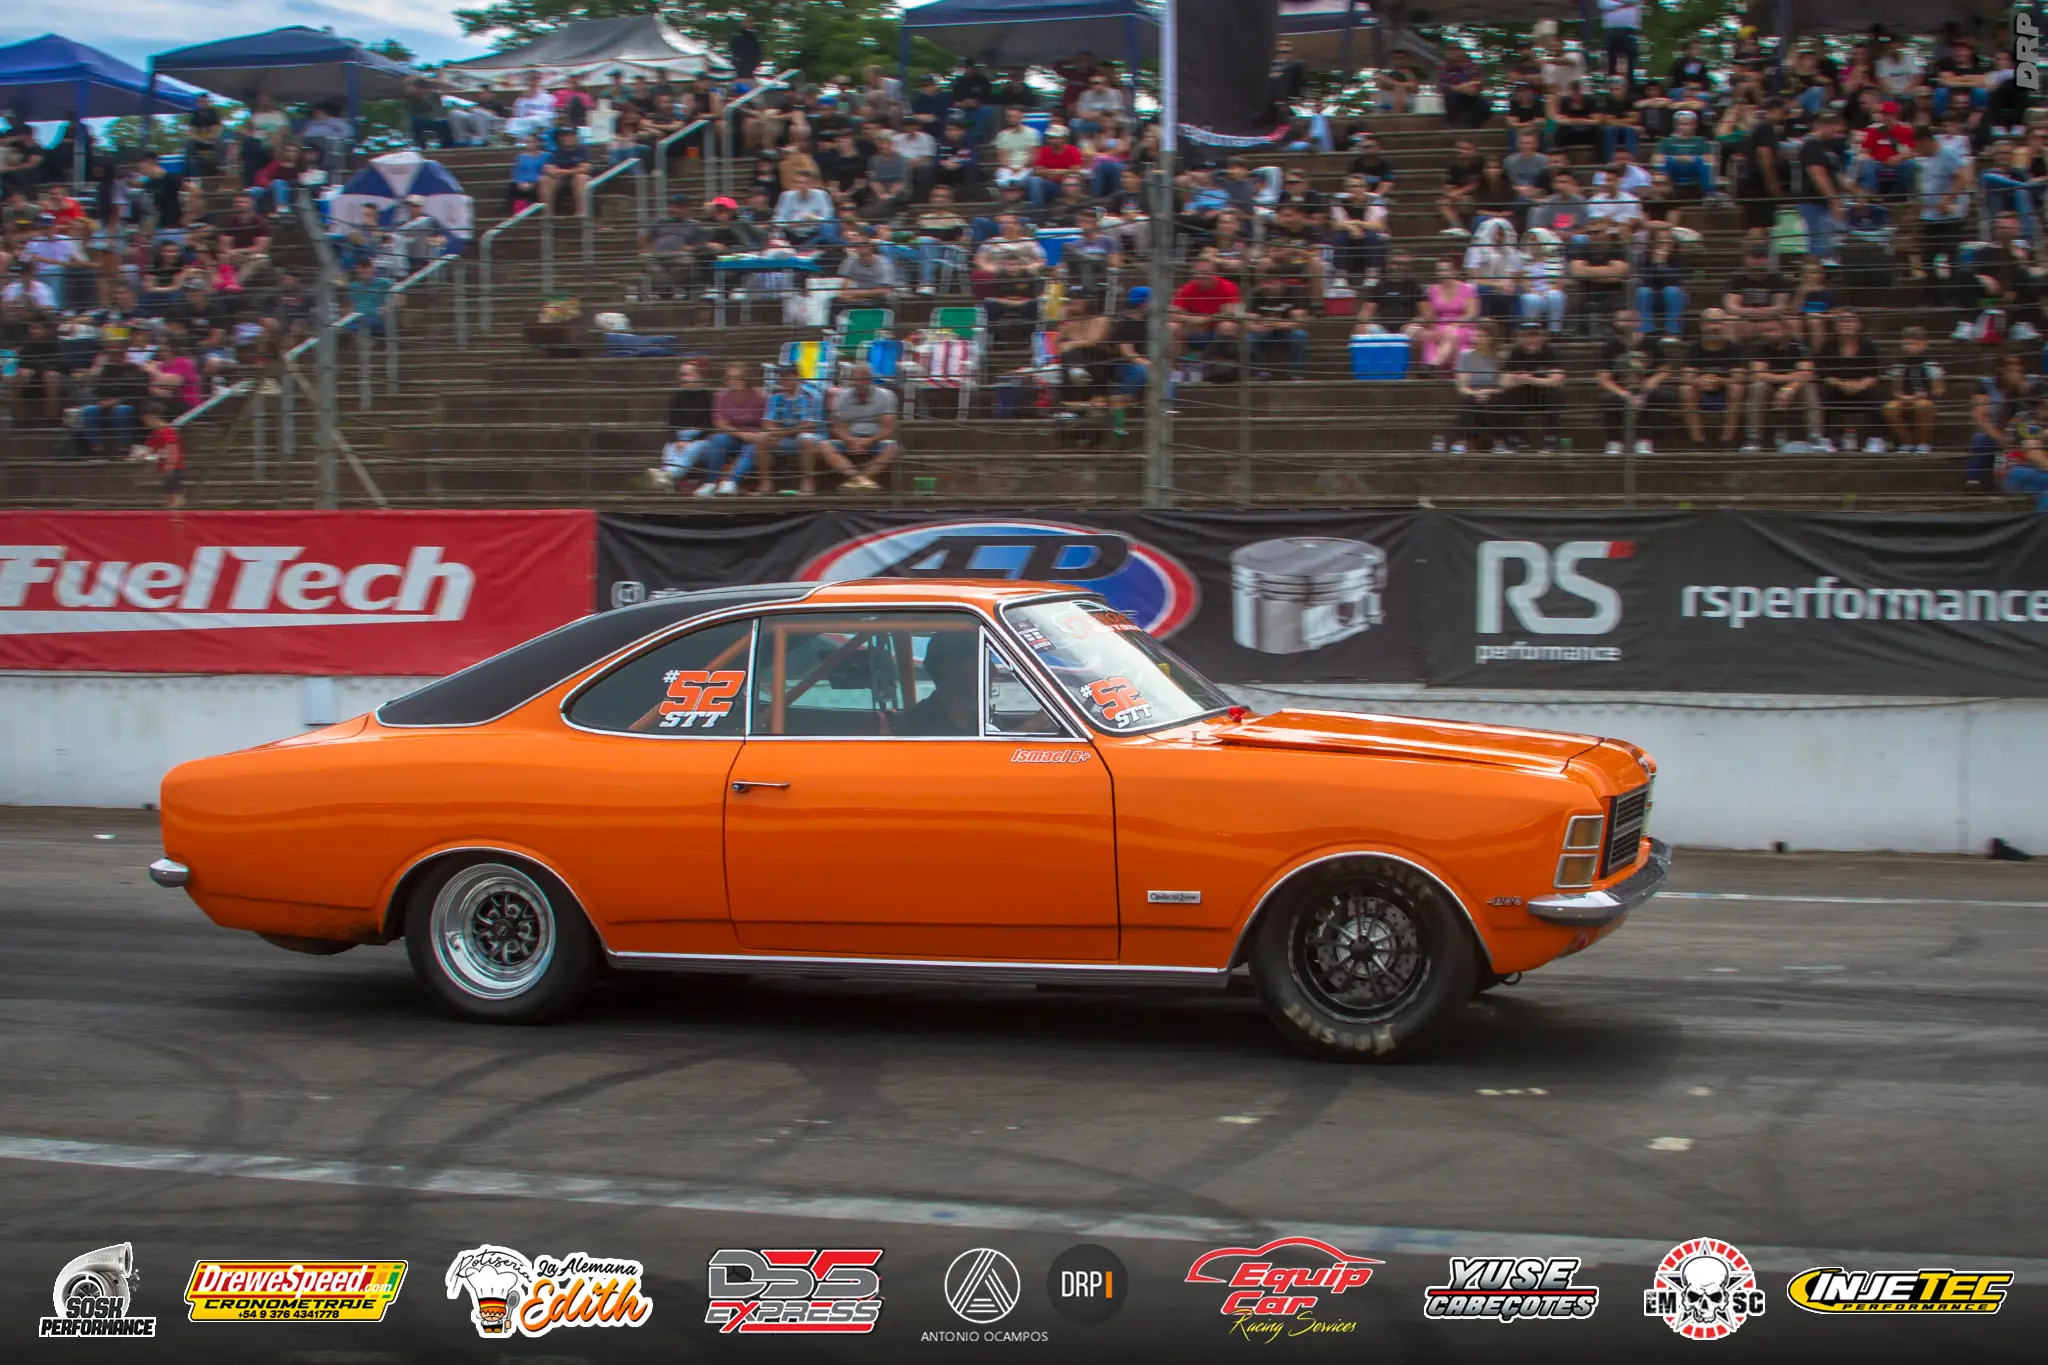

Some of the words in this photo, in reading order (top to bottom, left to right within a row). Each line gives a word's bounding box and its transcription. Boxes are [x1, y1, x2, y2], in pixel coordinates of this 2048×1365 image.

[0, 546, 475, 620] FuelTech
[1476, 541, 1634, 634] RS
[1681, 577, 2048, 628] rsperformance
[1475, 641, 1621, 664] performance
[659, 670, 746, 715] #52
[659, 711, 729, 727] STT
[1115, 704, 1152, 728] STT
